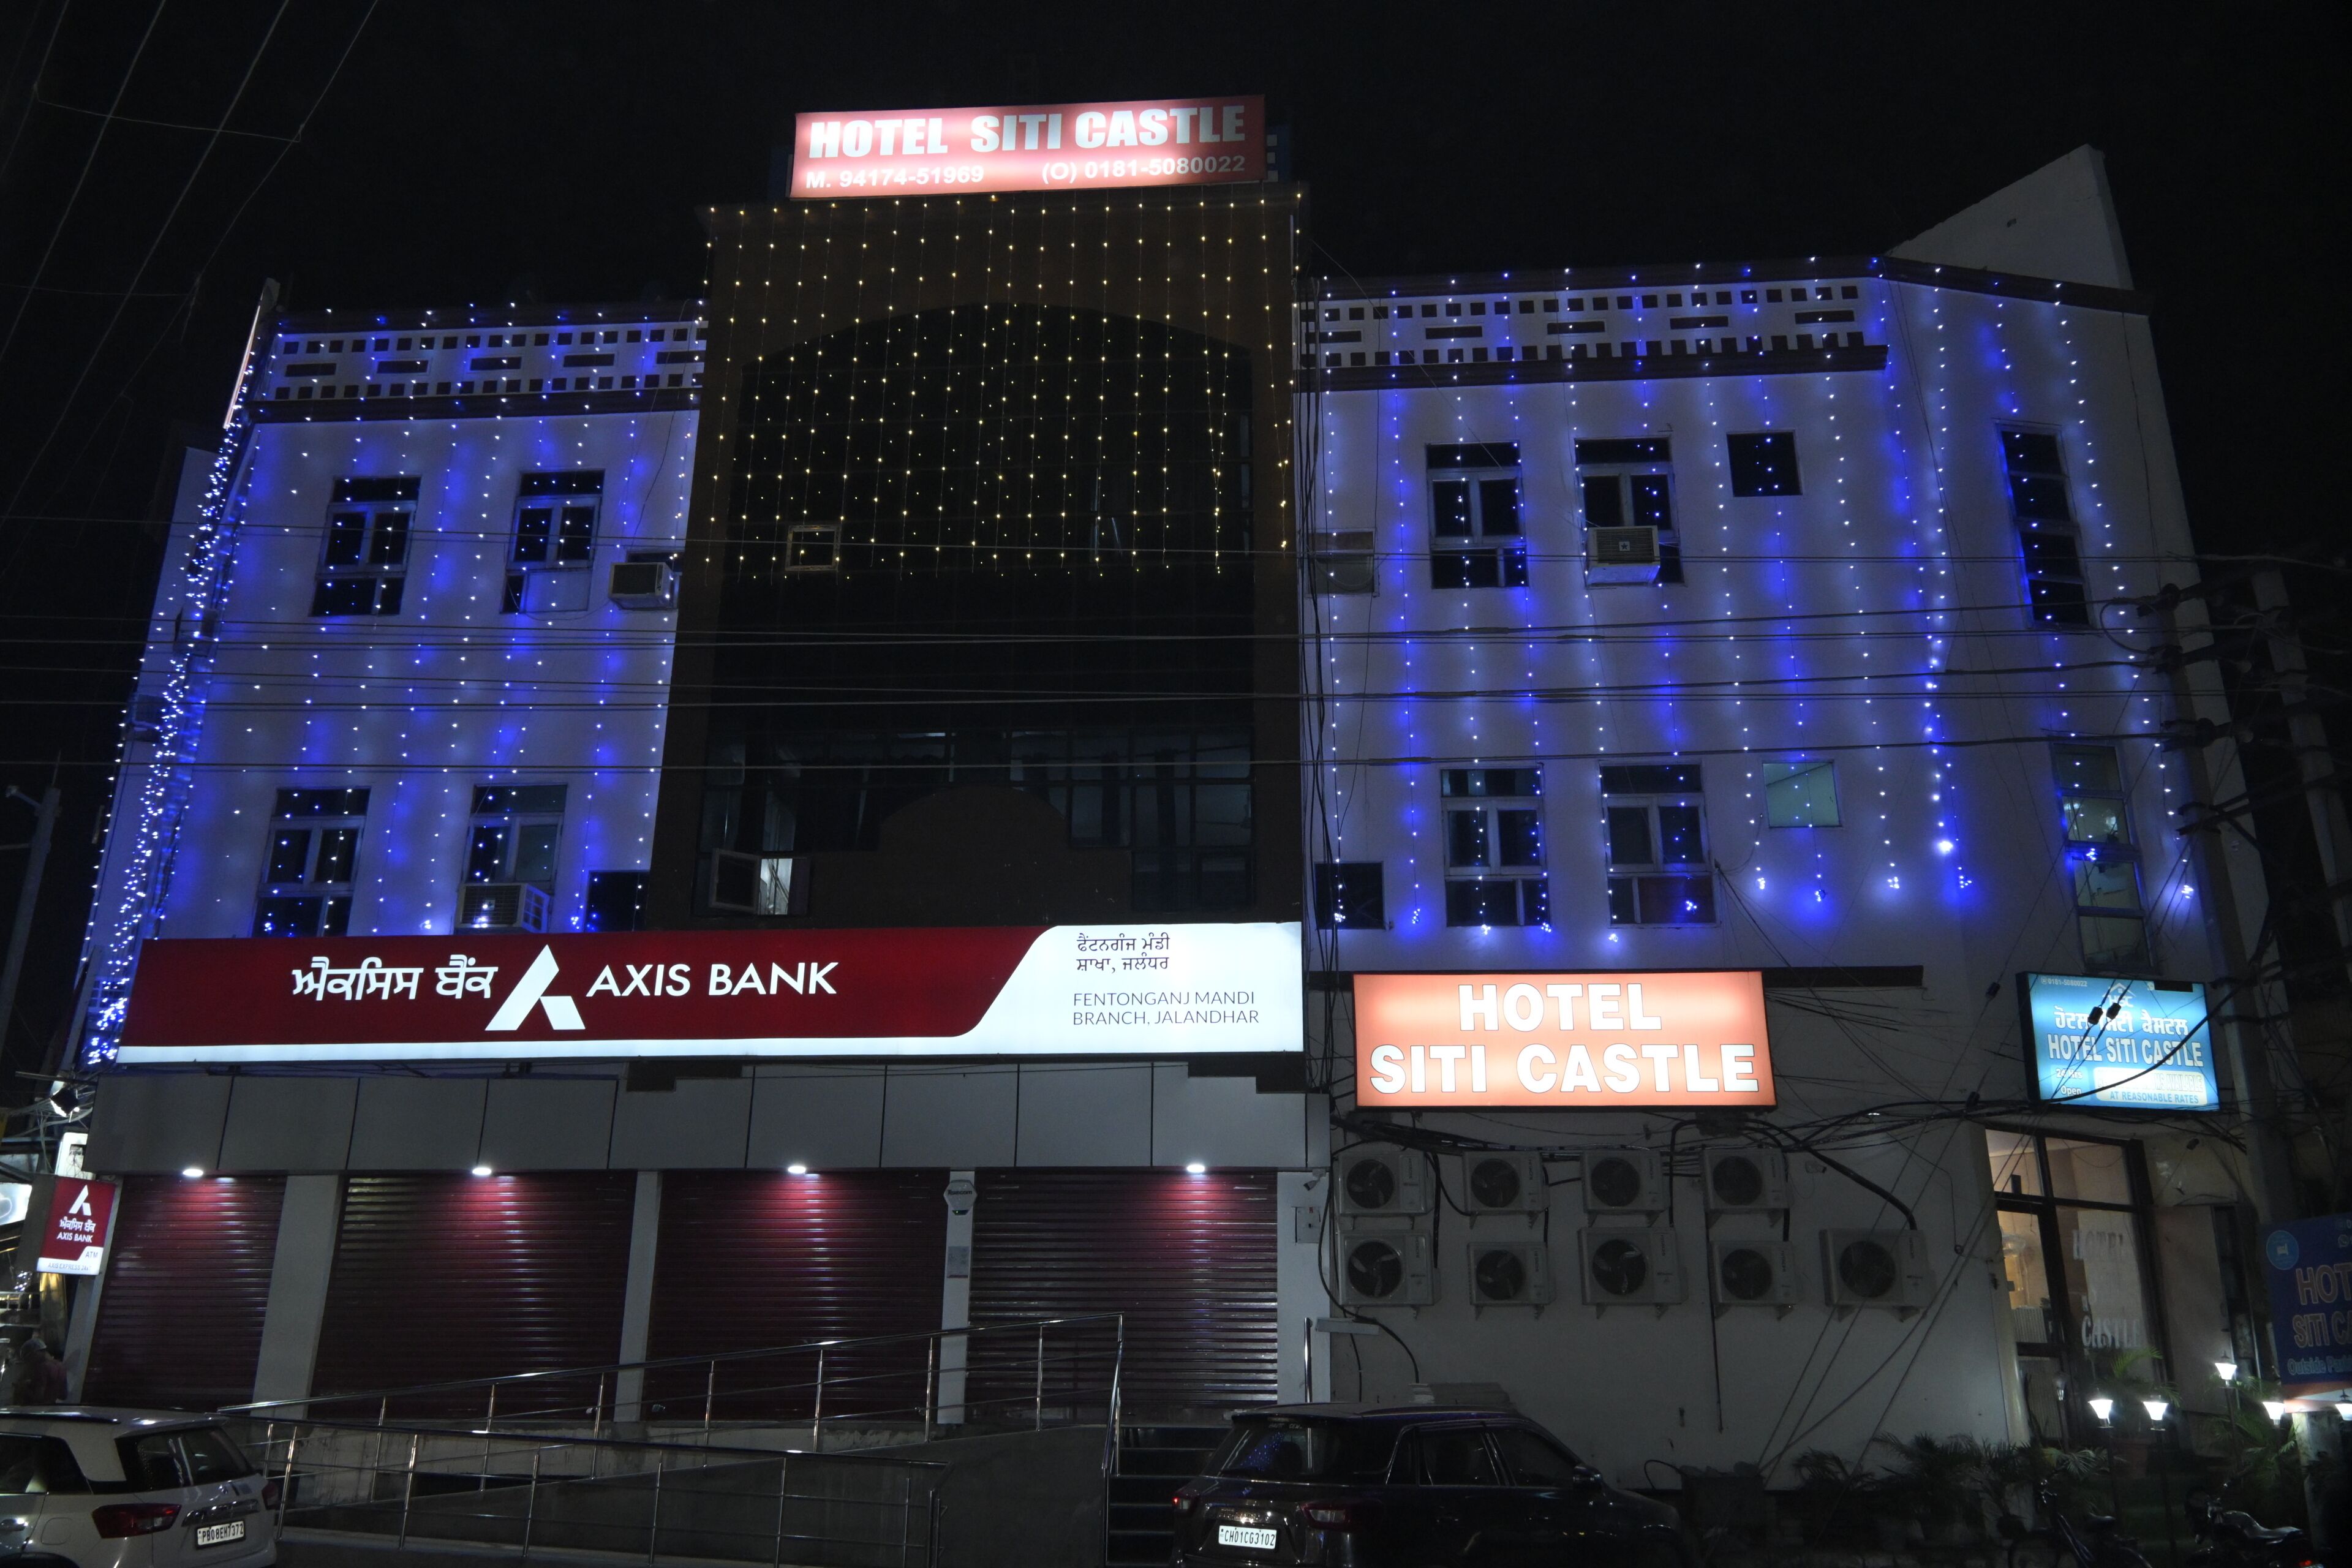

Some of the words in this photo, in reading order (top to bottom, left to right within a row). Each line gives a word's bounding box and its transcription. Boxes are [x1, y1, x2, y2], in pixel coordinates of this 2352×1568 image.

[809, 118, 948, 158] HOTEL
[971, 113, 1061, 152] SITI
[1074, 105, 1245, 149] CASTLE
[805, 167, 831, 188] M.
[839, 165, 984, 187] 94174-51969
[1042, 161, 1077, 184] (O)
[1084, 155, 1246, 179] 0181-5080022
[1076, 933, 1137, 952] ਫੈਂਟਨਗੰਜ
[1142, 932, 1170, 950] ਮੰਡੀ
[1121, 952, 1170, 970] ਜਲੰਧਰ
[291, 956, 424, 1001] ਐਕਸਿਸ
[435, 954, 499, 1000] ਬੈਂਕ
[586, 963, 692, 998] AXIS
[707, 962, 839, 996] BANK
[1074, 992, 1189, 1006] FENTONGANJ
[1195, 991, 1254, 1005] MANDI
[1458, 982, 1662, 1032] HOTEL
[1073, 1011, 1150, 1026] BRANCH,
[1155, 1010, 1259, 1025] JALANDHAR
[2048, 1034, 2102, 1061] HOTEL
[2106, 1038, 2138, 1063] SITI
[2141, 1039, 2203, 1067] CASTLE
[1370, 1044, 1487, 1094] SITI
[1516, 1043, 1759, 1093] CASTLE
[2060, 1085, 2082, 1096] Open
[2110, 1091, 2120, 1100] AT
[2122, 1091, 2173, 1102] REASONABLE
[2174, 1094, 2199, 1104] RATES
[57, 1232, 73, 1240] AXIS
[74, 1234, 93, 1243] BANK
[2292, 1313, 2330, 1348] SITI
[1224, 1530, 1275, 1546] CH01CG3102
